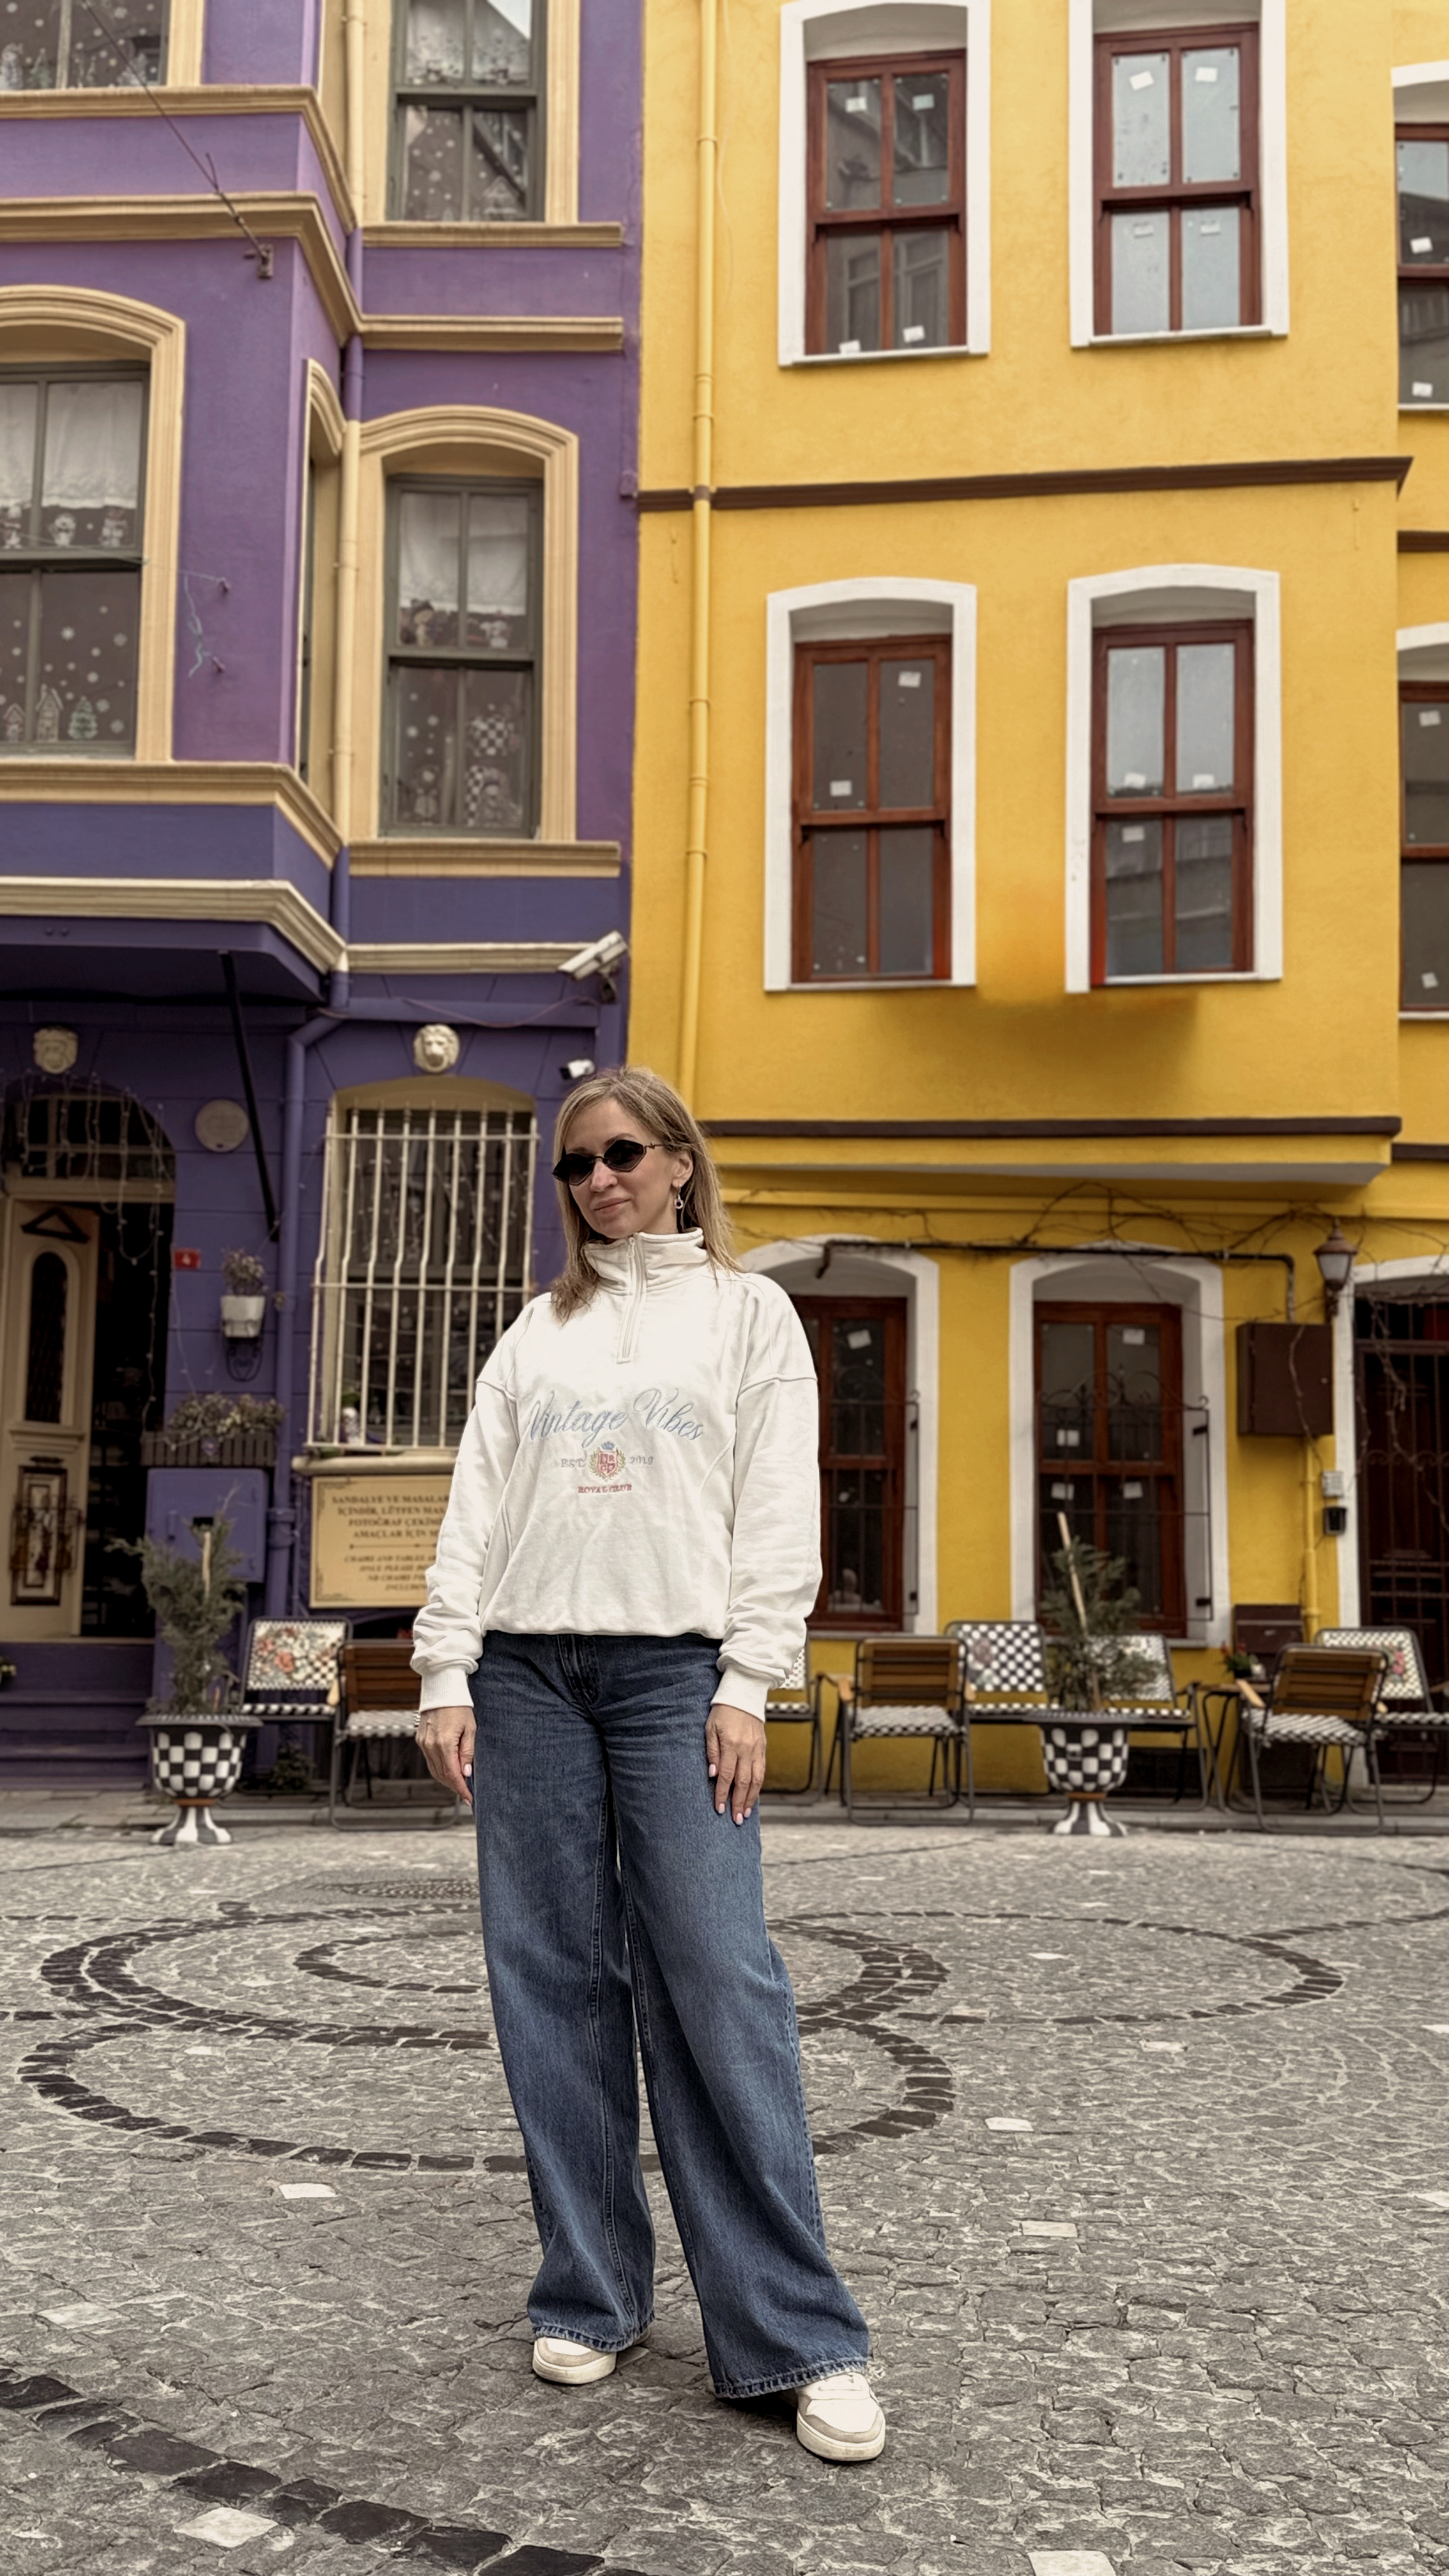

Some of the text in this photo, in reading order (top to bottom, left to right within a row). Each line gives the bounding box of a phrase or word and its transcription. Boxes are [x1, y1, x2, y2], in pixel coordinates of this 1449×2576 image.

[528, 1388, 705, 1448] Vintage Vibes
[332, 1495, 383, 1504] SANDALYE
[349, 1517, 402, 1527] FOTOĞRAF
[354, 1529, 402, 1539] AMAÇLAR
